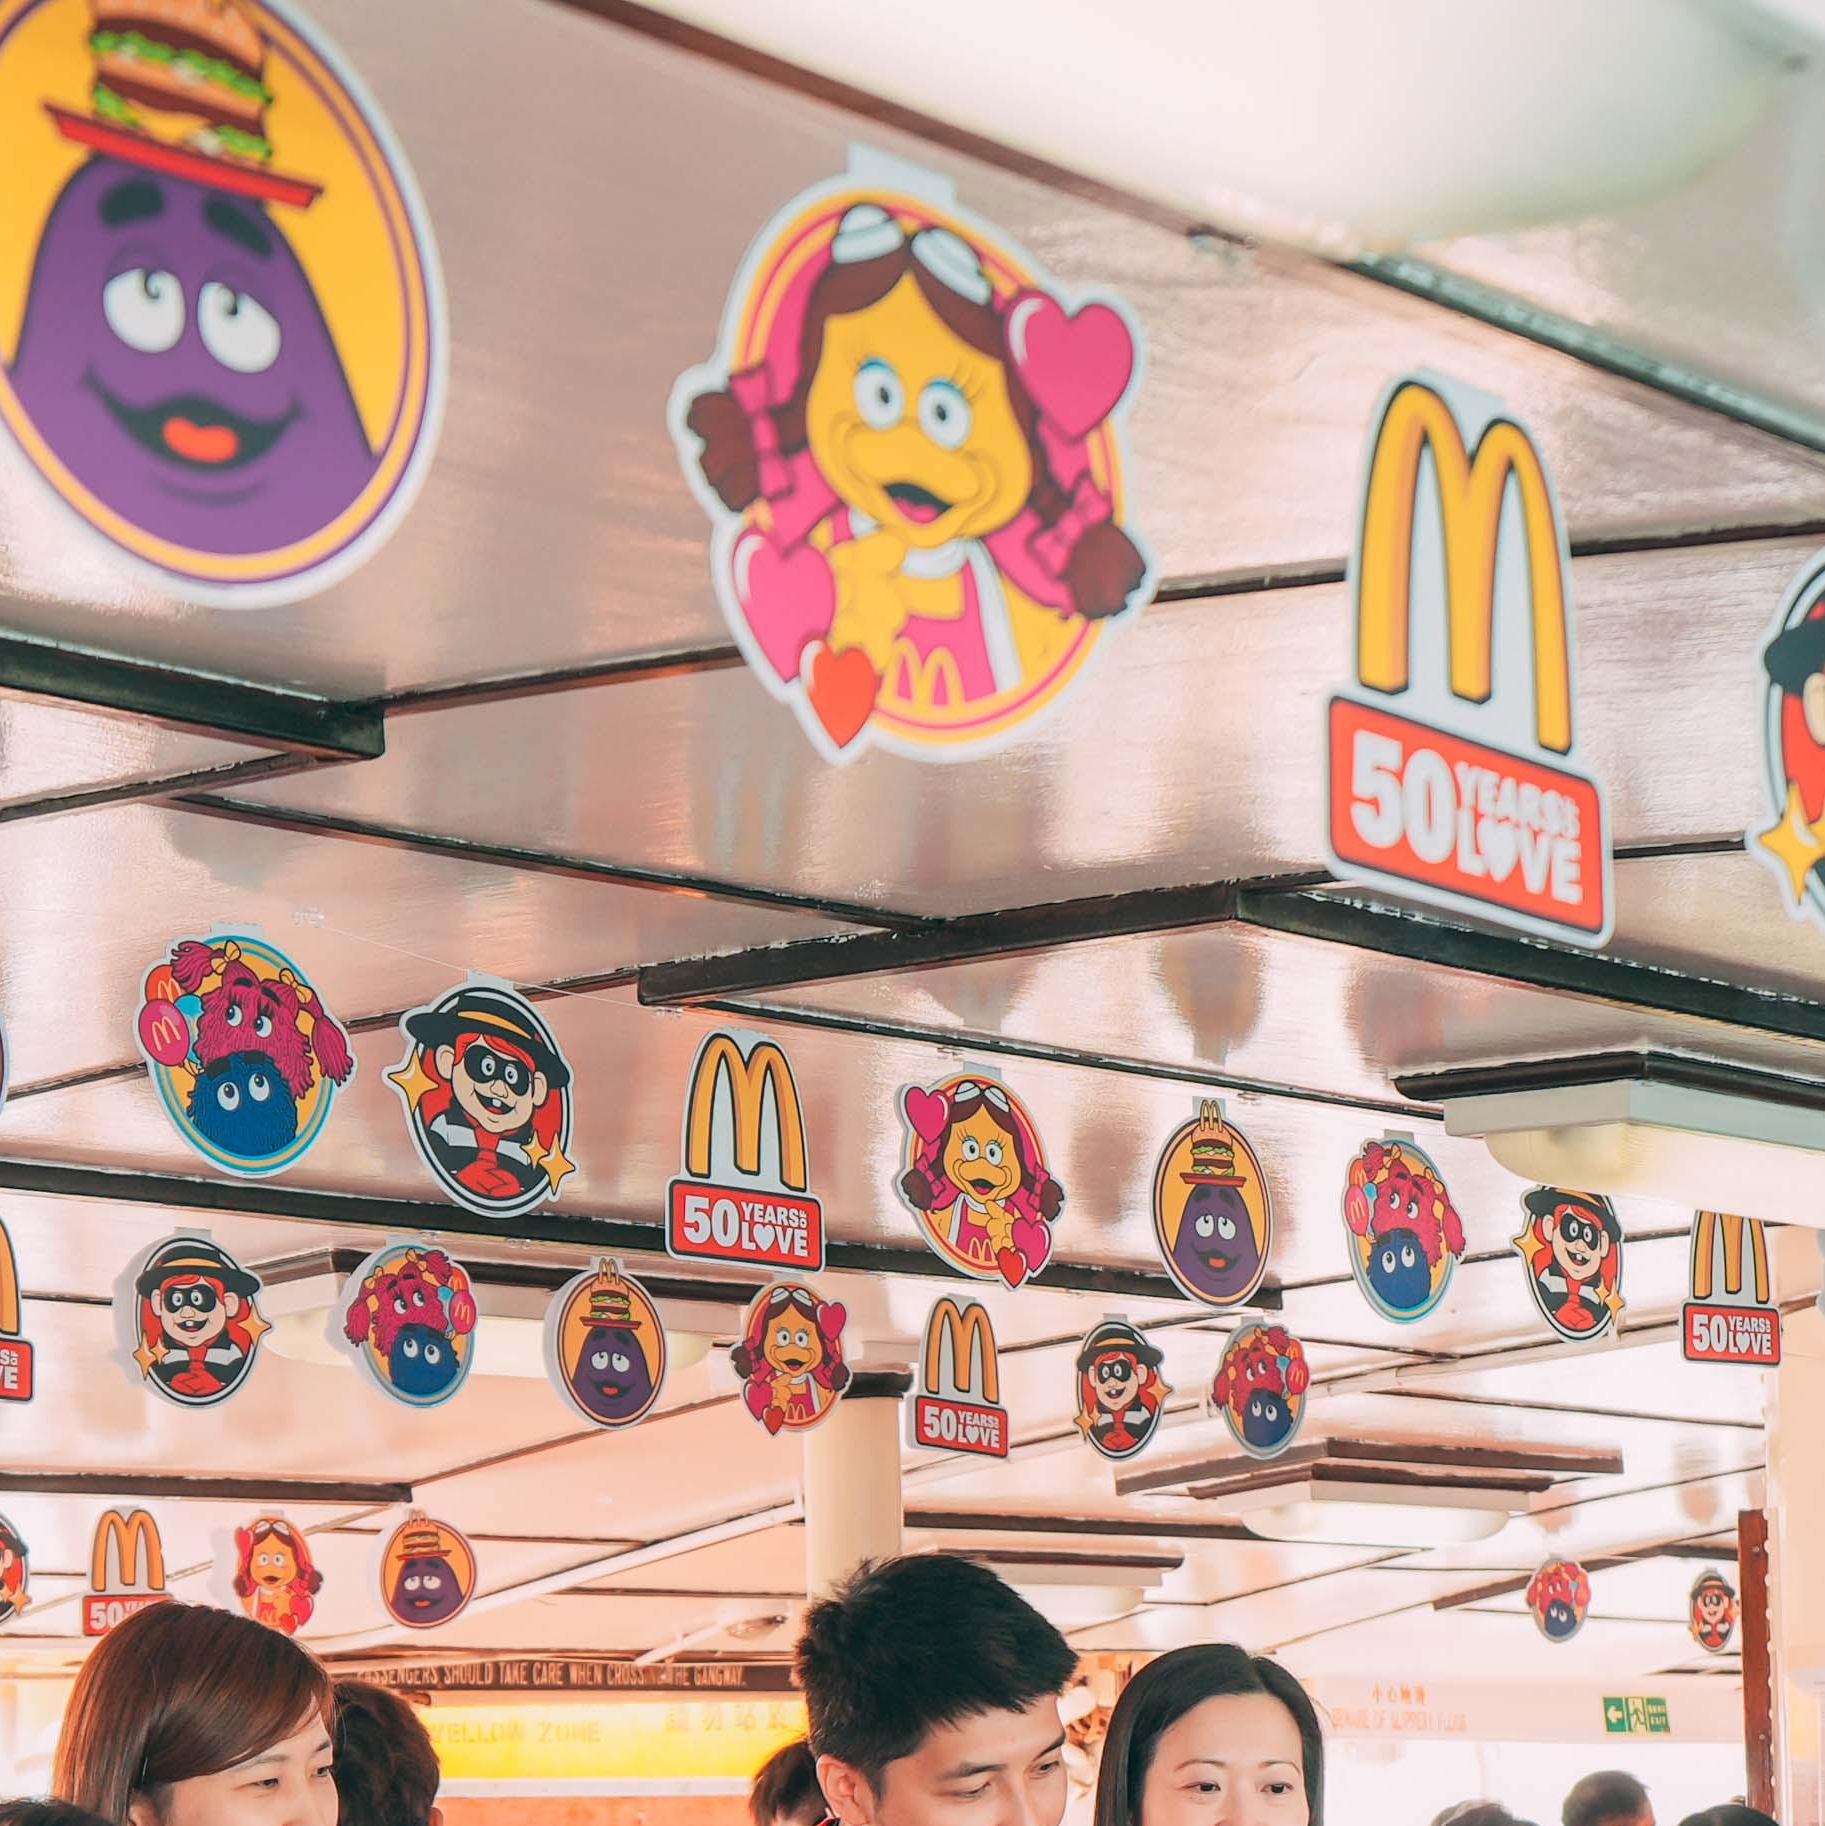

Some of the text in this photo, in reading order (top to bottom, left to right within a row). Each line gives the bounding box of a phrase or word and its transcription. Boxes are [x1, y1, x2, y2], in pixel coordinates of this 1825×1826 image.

[1351, 729, 1460, 864] 50
[1454, 760, 1567, 826] YEARS
[684, 1195, 740, 1247] 50
[741, 1202, 798, 1226] YEARS
[1693, 1315, 1727, 1352] 50
[1728, 1316, 1765, 1333] YEARS
[924, 1406, 957, 1440] 50
[444, 1662, 493, 1685] SHOULD
[500, 1662, 528, 1685] TAKE
[533, 1662, 565, 1685] CARE
[570, 1663, 603, 1685] WHEN
